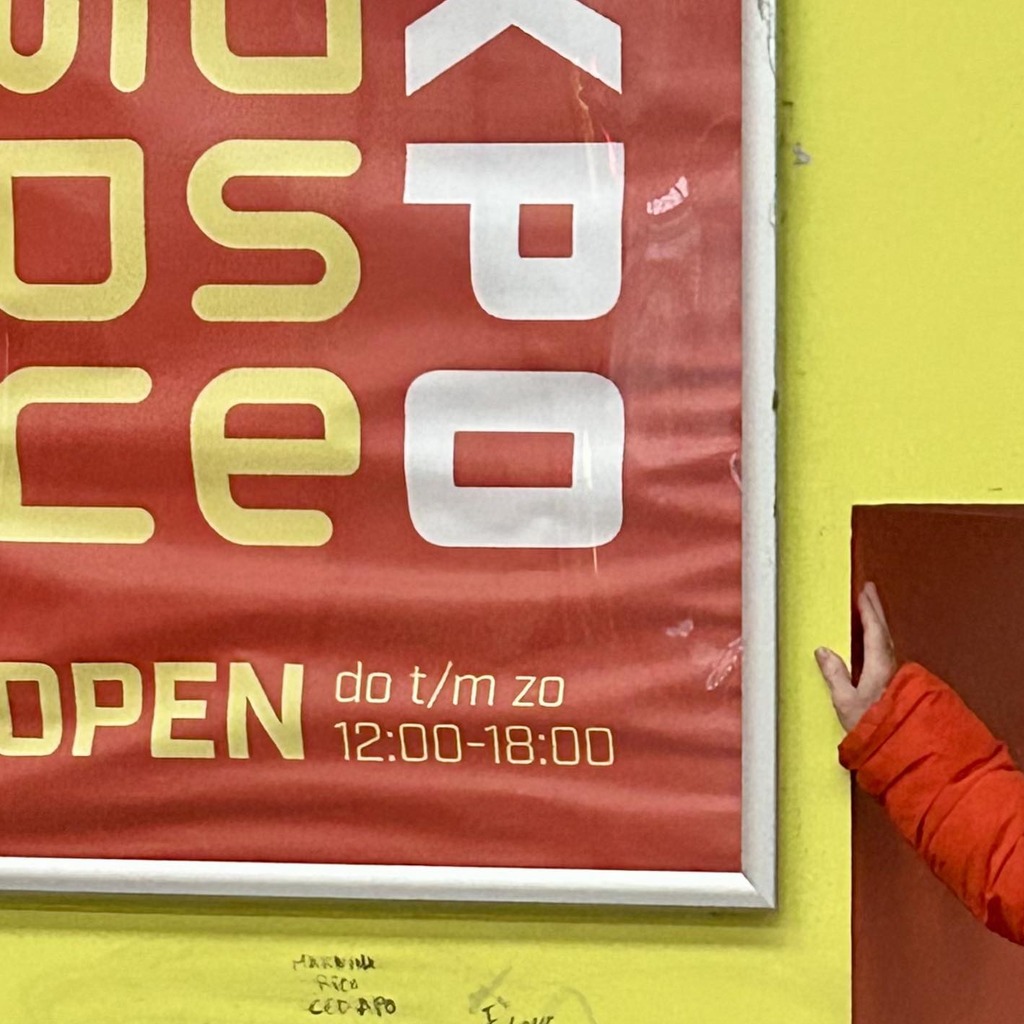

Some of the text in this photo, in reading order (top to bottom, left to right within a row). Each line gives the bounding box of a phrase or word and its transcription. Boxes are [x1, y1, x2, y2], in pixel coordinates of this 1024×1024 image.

[335, 660, 566, 710] do t/m zo
[0, 661, 305, 760] OPEN
[333, 721, 615, 766] 12:00-18:00
